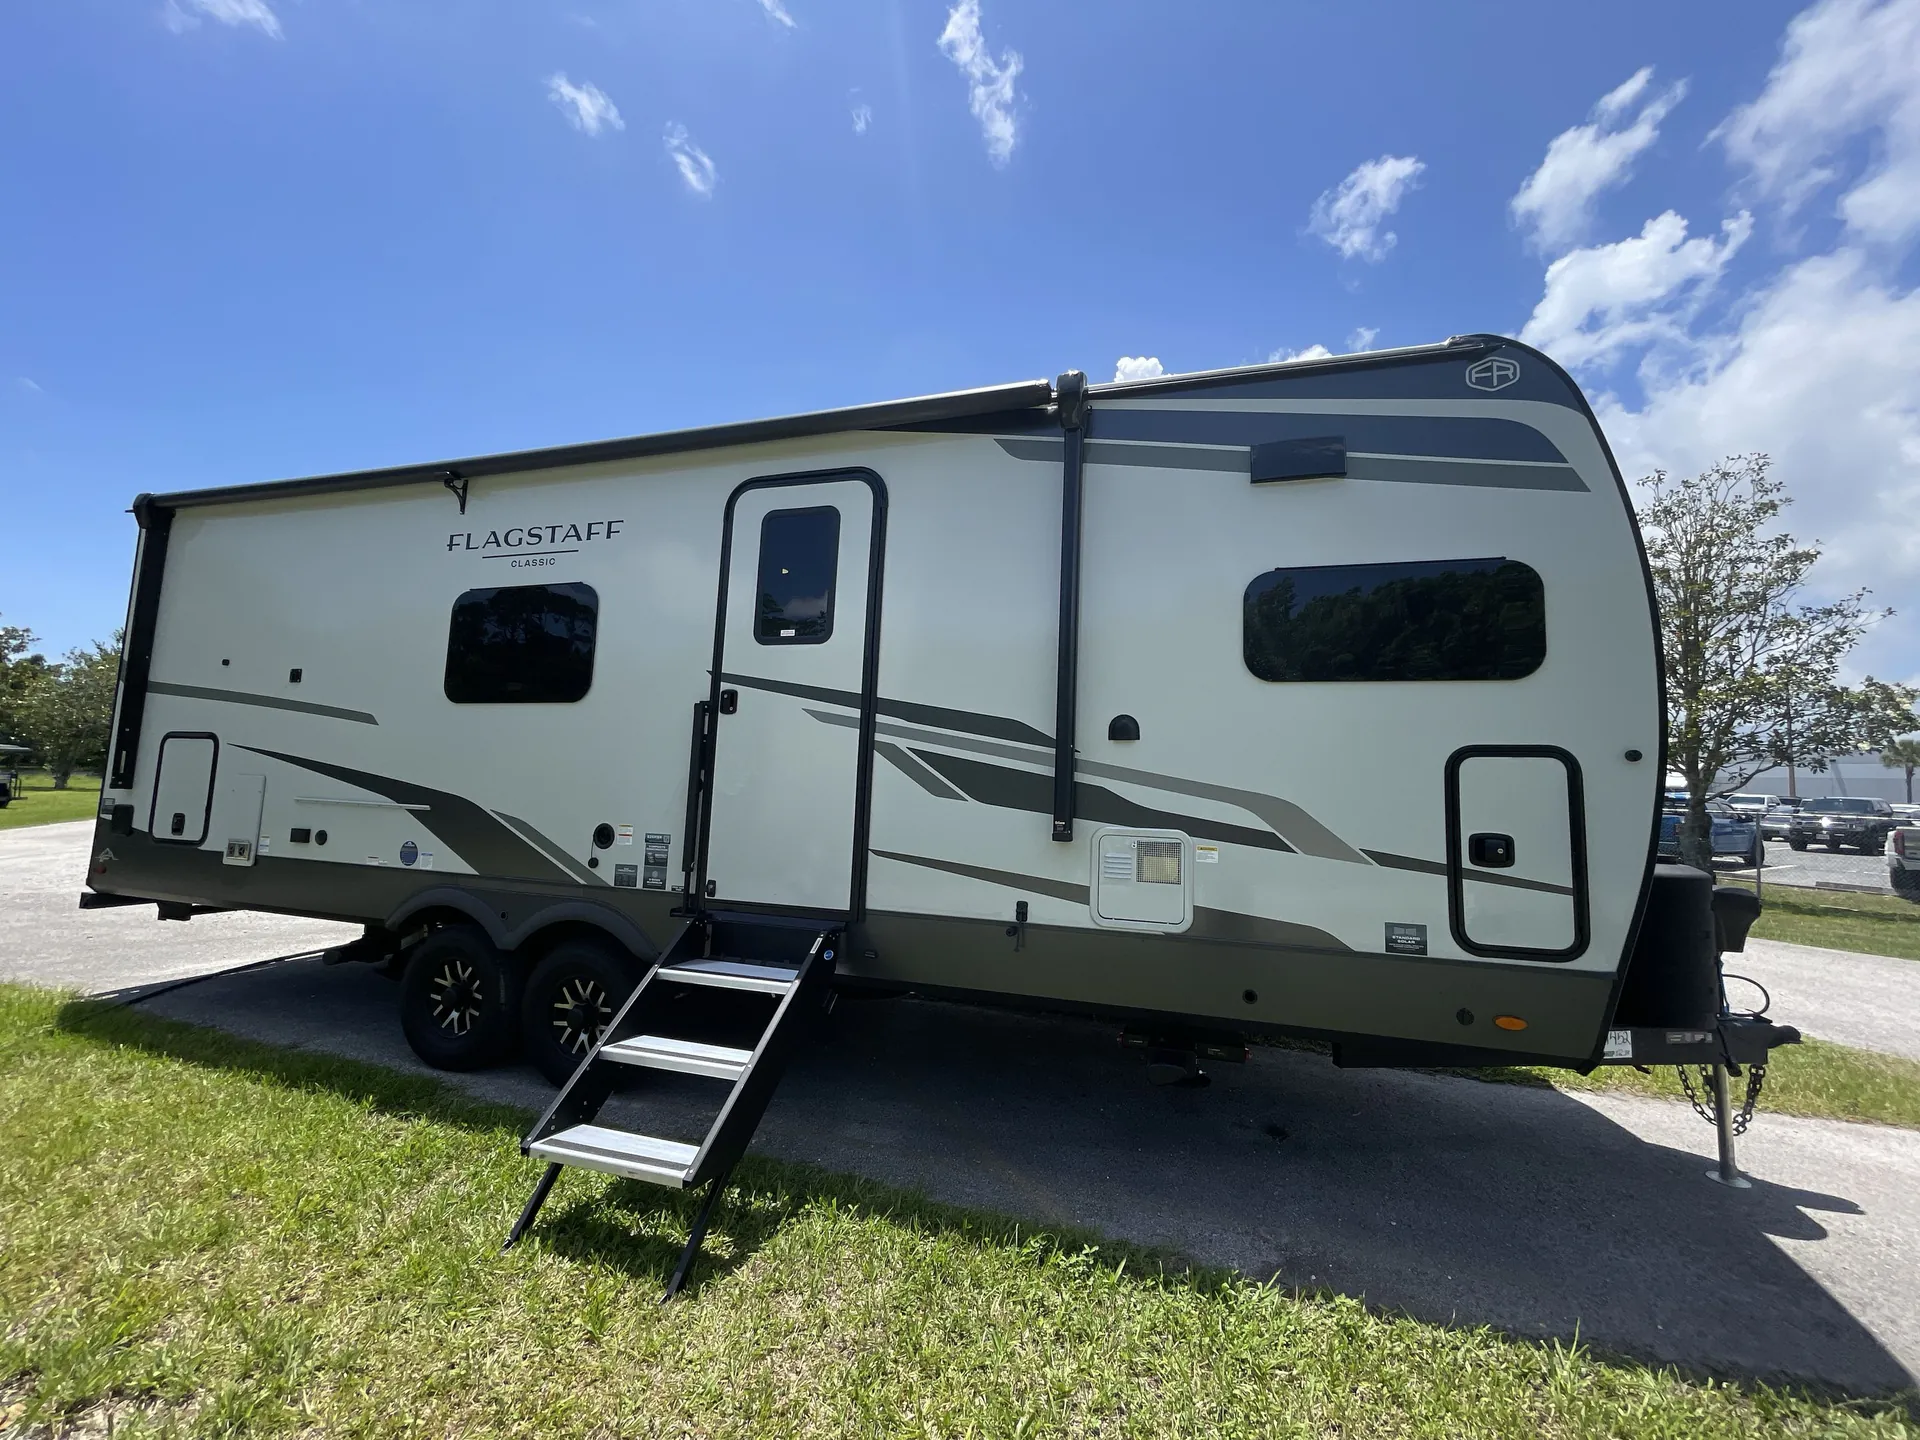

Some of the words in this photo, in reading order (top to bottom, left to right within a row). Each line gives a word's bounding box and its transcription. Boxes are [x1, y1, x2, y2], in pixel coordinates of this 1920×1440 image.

[1471, 361, 1514, 387] FR
[446, 519, 625, 552] FLAGSTAFF
[510, 557, 556, 568] CLASSIC
